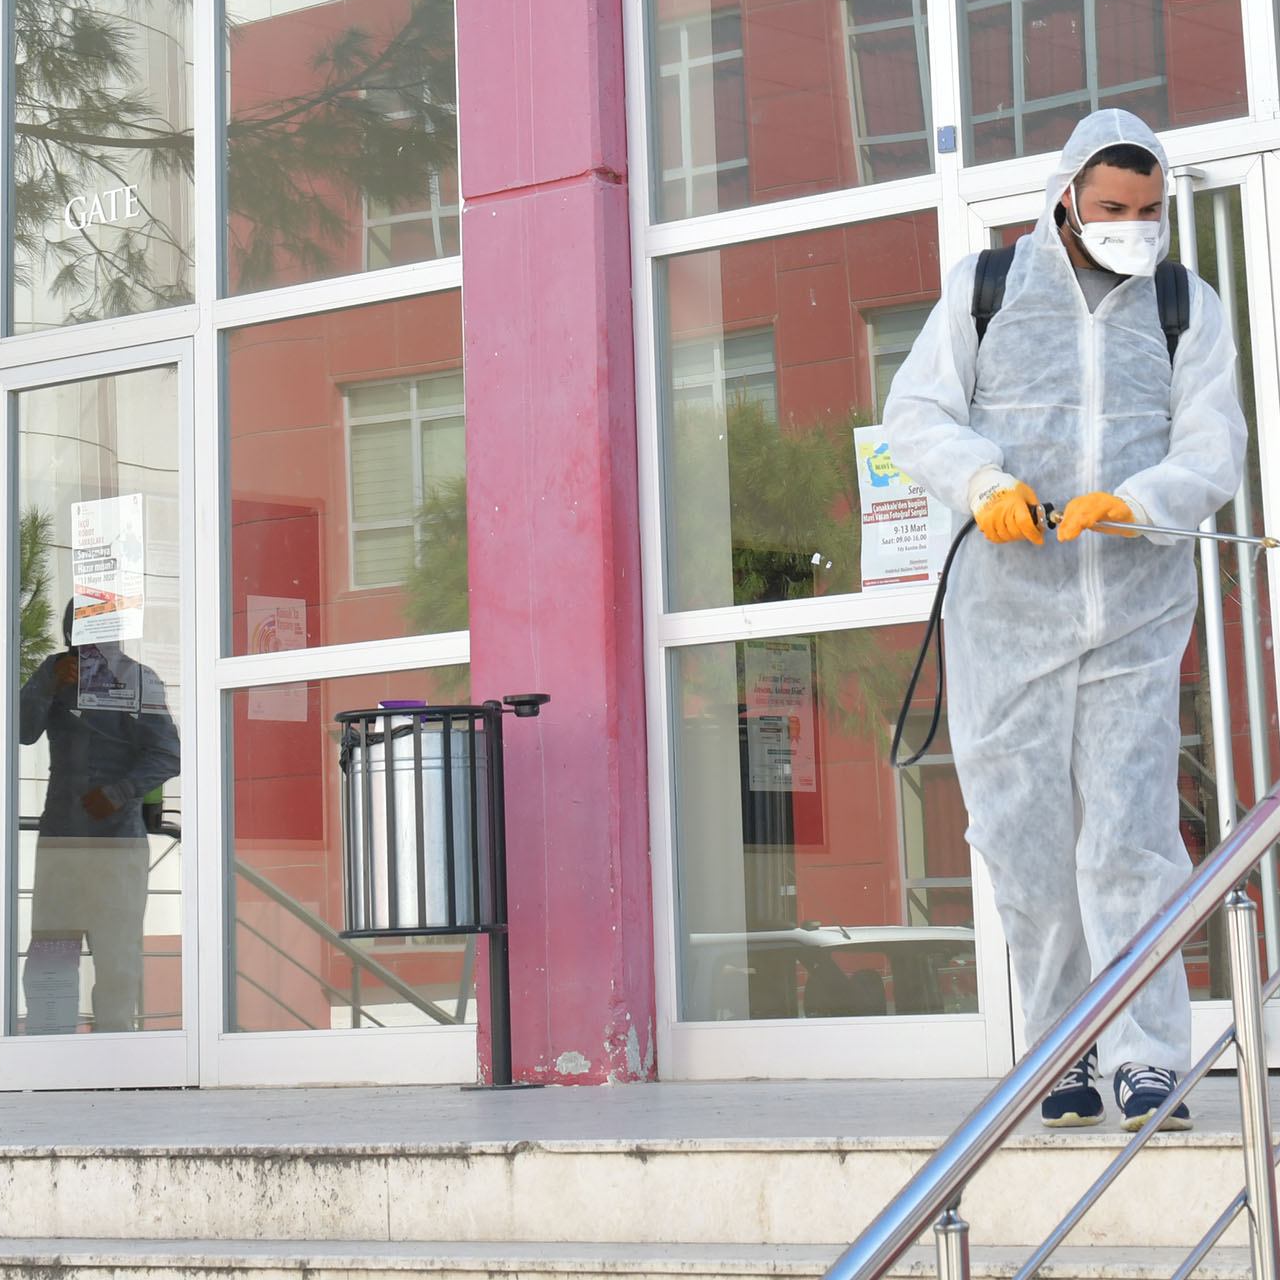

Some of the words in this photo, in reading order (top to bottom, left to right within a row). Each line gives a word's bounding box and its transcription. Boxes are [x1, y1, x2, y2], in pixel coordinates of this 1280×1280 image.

[65, 184, 140, 230] GATE
[894, 526, 909, 535] 9-13
[910, 523, 927, 532] Mart
